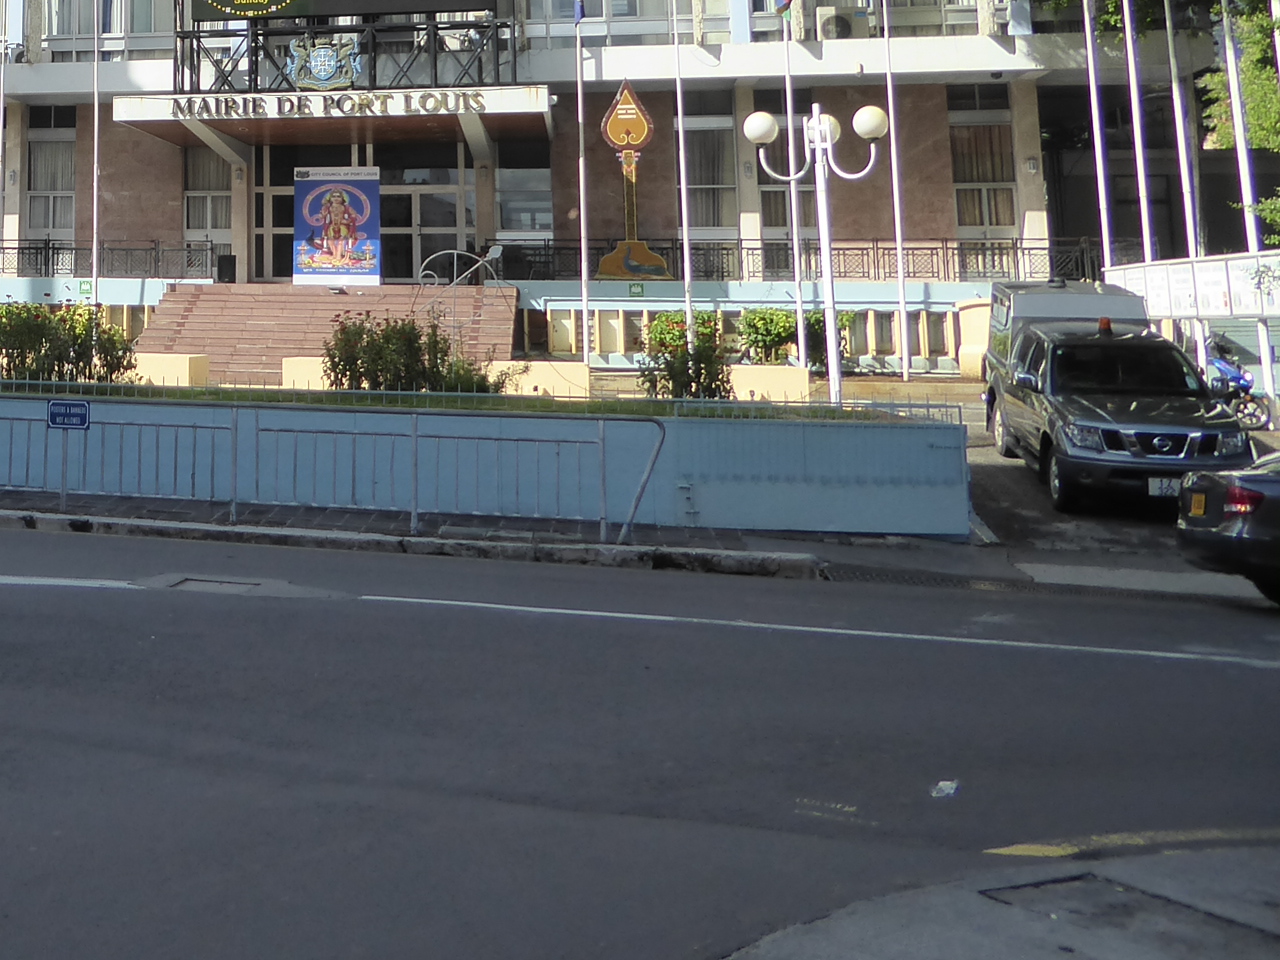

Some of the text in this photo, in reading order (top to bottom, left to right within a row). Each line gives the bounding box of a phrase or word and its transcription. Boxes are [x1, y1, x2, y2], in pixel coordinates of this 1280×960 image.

[170, 90, 487, 118] MAIRIE DE PORT LOUIS
